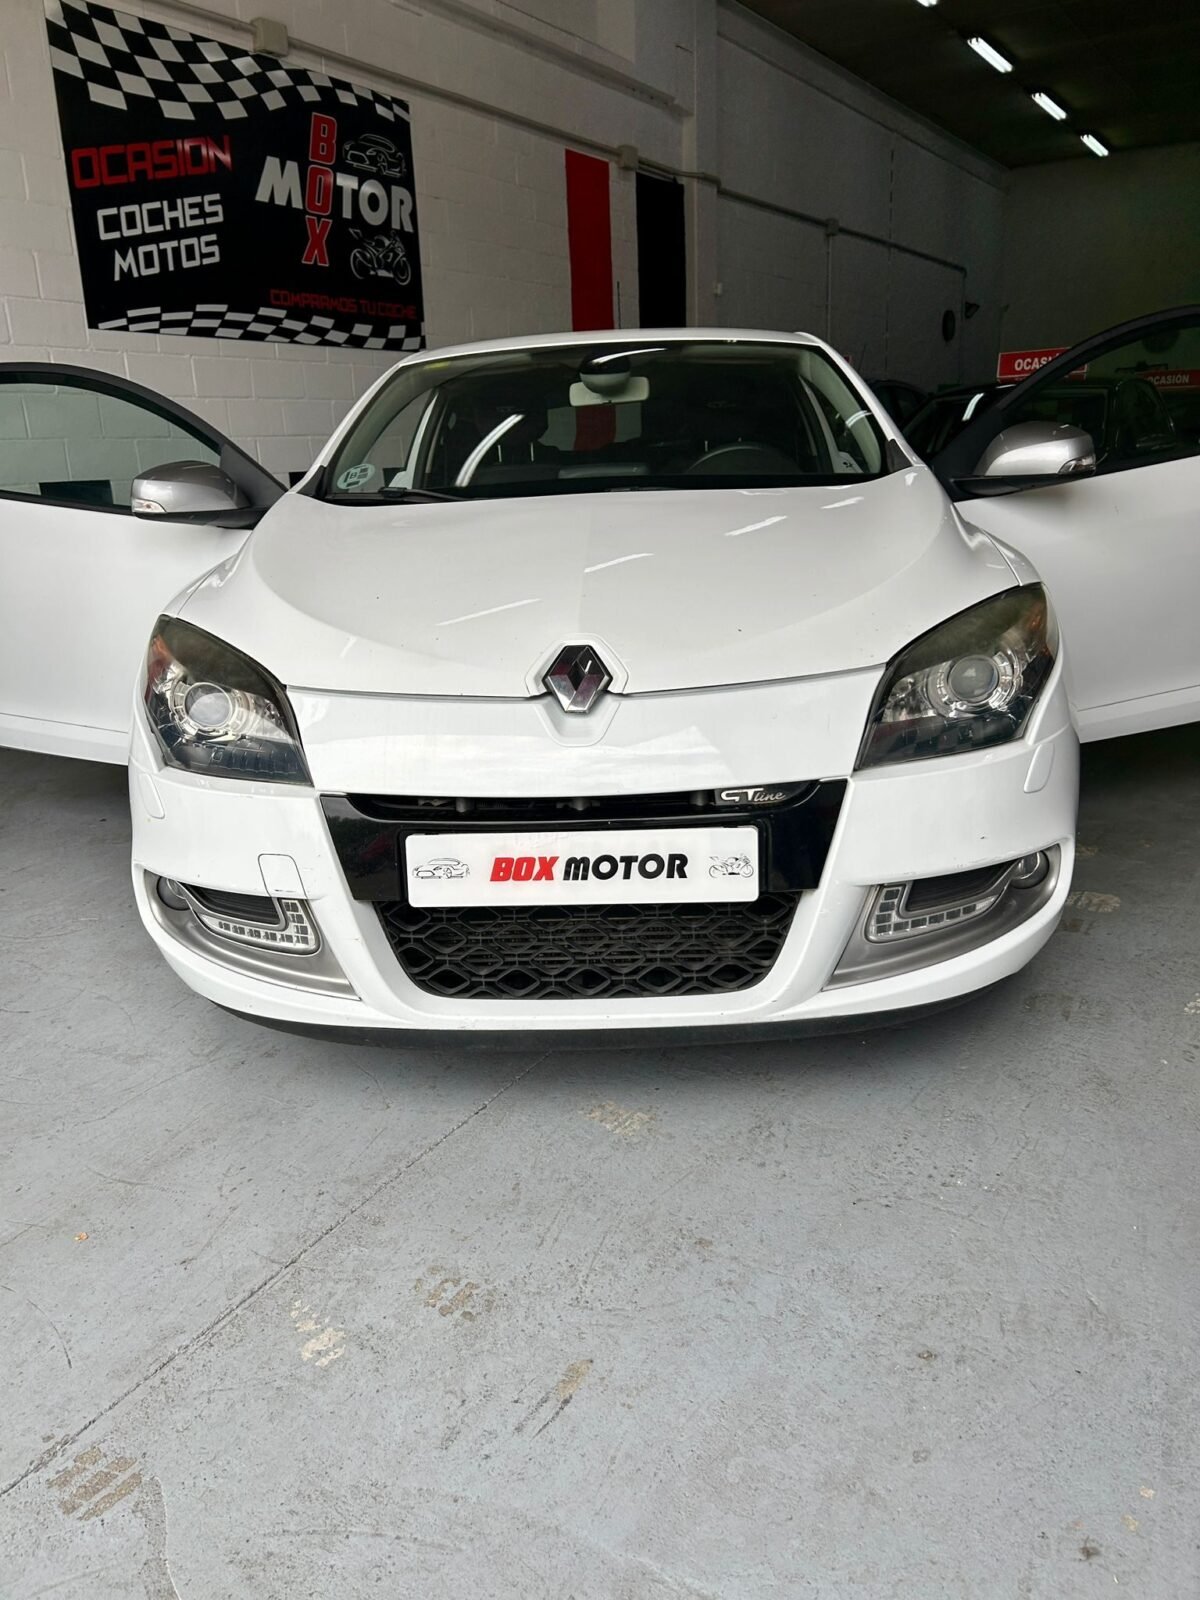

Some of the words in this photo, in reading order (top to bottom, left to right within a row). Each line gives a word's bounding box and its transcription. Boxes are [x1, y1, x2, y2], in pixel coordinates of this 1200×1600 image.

[71, 135, 232, 189] OCASION
[255, 155, 414, 233] MOTOR
[302, 112, 337, 266] BOX
[97, 193, 223, 240] COCHES
[114, 234, 220, 281] MOTOS
[270, 289, 357, 313] COMPRAMOS
[360, 299, 375, 315] TU
[378, 302, 417, 319] COCHE
[1014, 353, 1060, 371] OCAS
[489, 856, 559, 882] BOX
[562, 853, 688, 882] MOTOR
